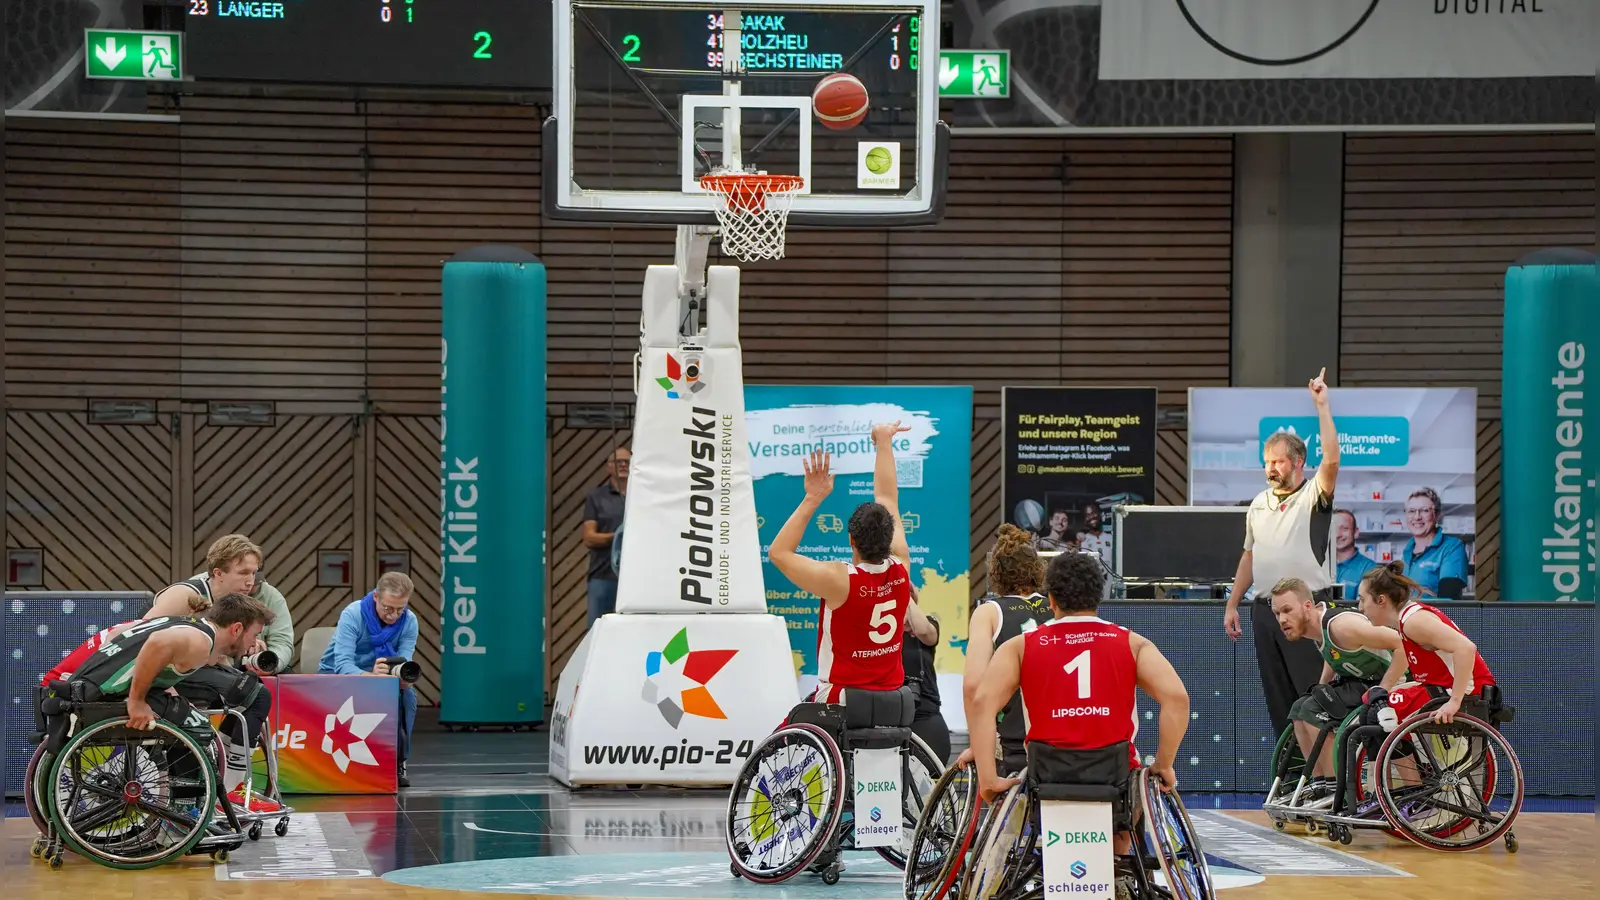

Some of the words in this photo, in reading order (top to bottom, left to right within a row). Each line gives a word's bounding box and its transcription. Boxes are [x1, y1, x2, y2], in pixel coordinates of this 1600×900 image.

[189, 0, 209, 16] 23
[218, 1, 284, 19] LANGER
[407, 8, 413, 23] 1
[707, 14, 724, 30] 34
[472, 32, 492, 59] 2
[622, 34, 641, 62] 2
[707, 33, 723, 48] 41
[890, 36, 897, 51] 1
[707, 52, 723, 67] 99
[890, 54, 900, 70] 0
[773, 424, 805, 435] Deine
[1018, 414, 1037, 425] Für
[1038, 414, 1083, 427] Fairplay,
[1084, 414, 1140, 429] Teamgeist
[1018, 429, 1040, 438] und
[1041, 430, 1078, 438] unsere
[1080, 429, 1117, 442] Region
[748, 436, 910, 458] Versandapothke
[1049, 445, 1079, 453] Instagram
[720, 414, 733, 516] INDUSTRIESERVICE
[448, 456, 478, 563] Klick
[679, 406, 716, 605] Piotrowski
[720, 520, 730, 545] UND
[716, 549, 730, 606] GEBÄUDE-
[766, 590, 791, 599] über
[793, 590, 808, 599] 40
[453, 576, 486, 654] per
[868, 599, 898, 645] 5
[804, 620, 814, 629] in
[1063, 650, 1091, 699] 1
[1052, 706, 1110, 718] LIPSCOMB
[868, 781, 897, 793] DEKRA
[857, 824, 898, 835] schlaeger
[1066, 832, 1107, 844] DEKRA
[1049, 882, 1110, 894] schlaeger
